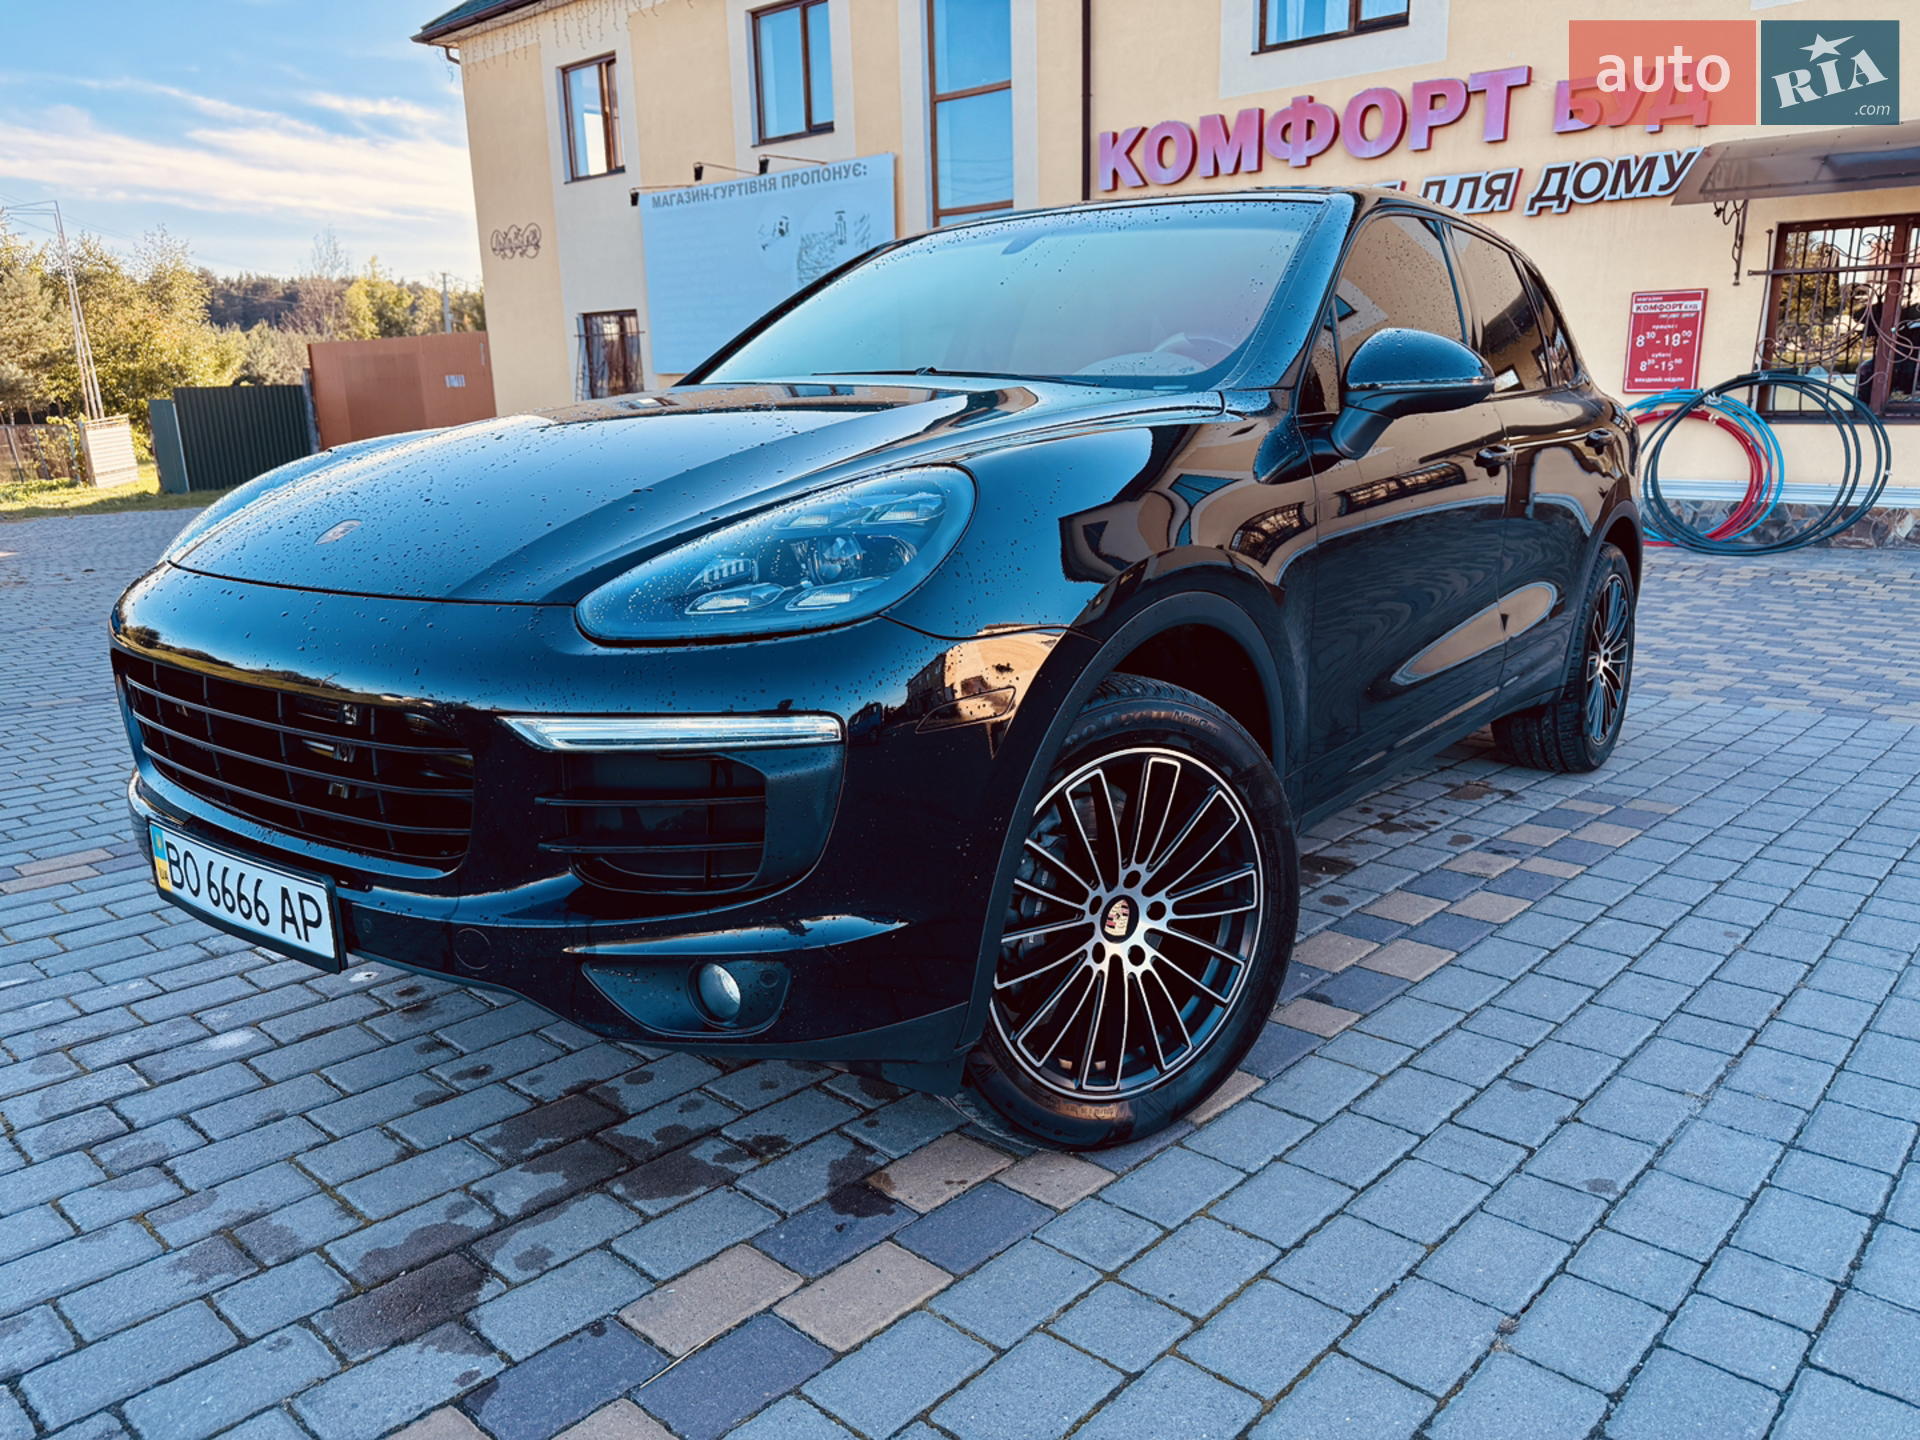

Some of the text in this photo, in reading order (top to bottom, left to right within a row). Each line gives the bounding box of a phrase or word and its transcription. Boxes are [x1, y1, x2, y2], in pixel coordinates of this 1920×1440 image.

[1098, 59, 1712, 192] КОМФОРТ БУД
[651, 162, 868, 209] МАГАЗИН-ГУРТІВНЯ ПРОПОНУЄ:
[1524, 147, 1707, 216] ДОМУ
[1635, 302, 1684, 312] КОМФОРТ
[165, 839, 322, 943] BO 6666 AP
